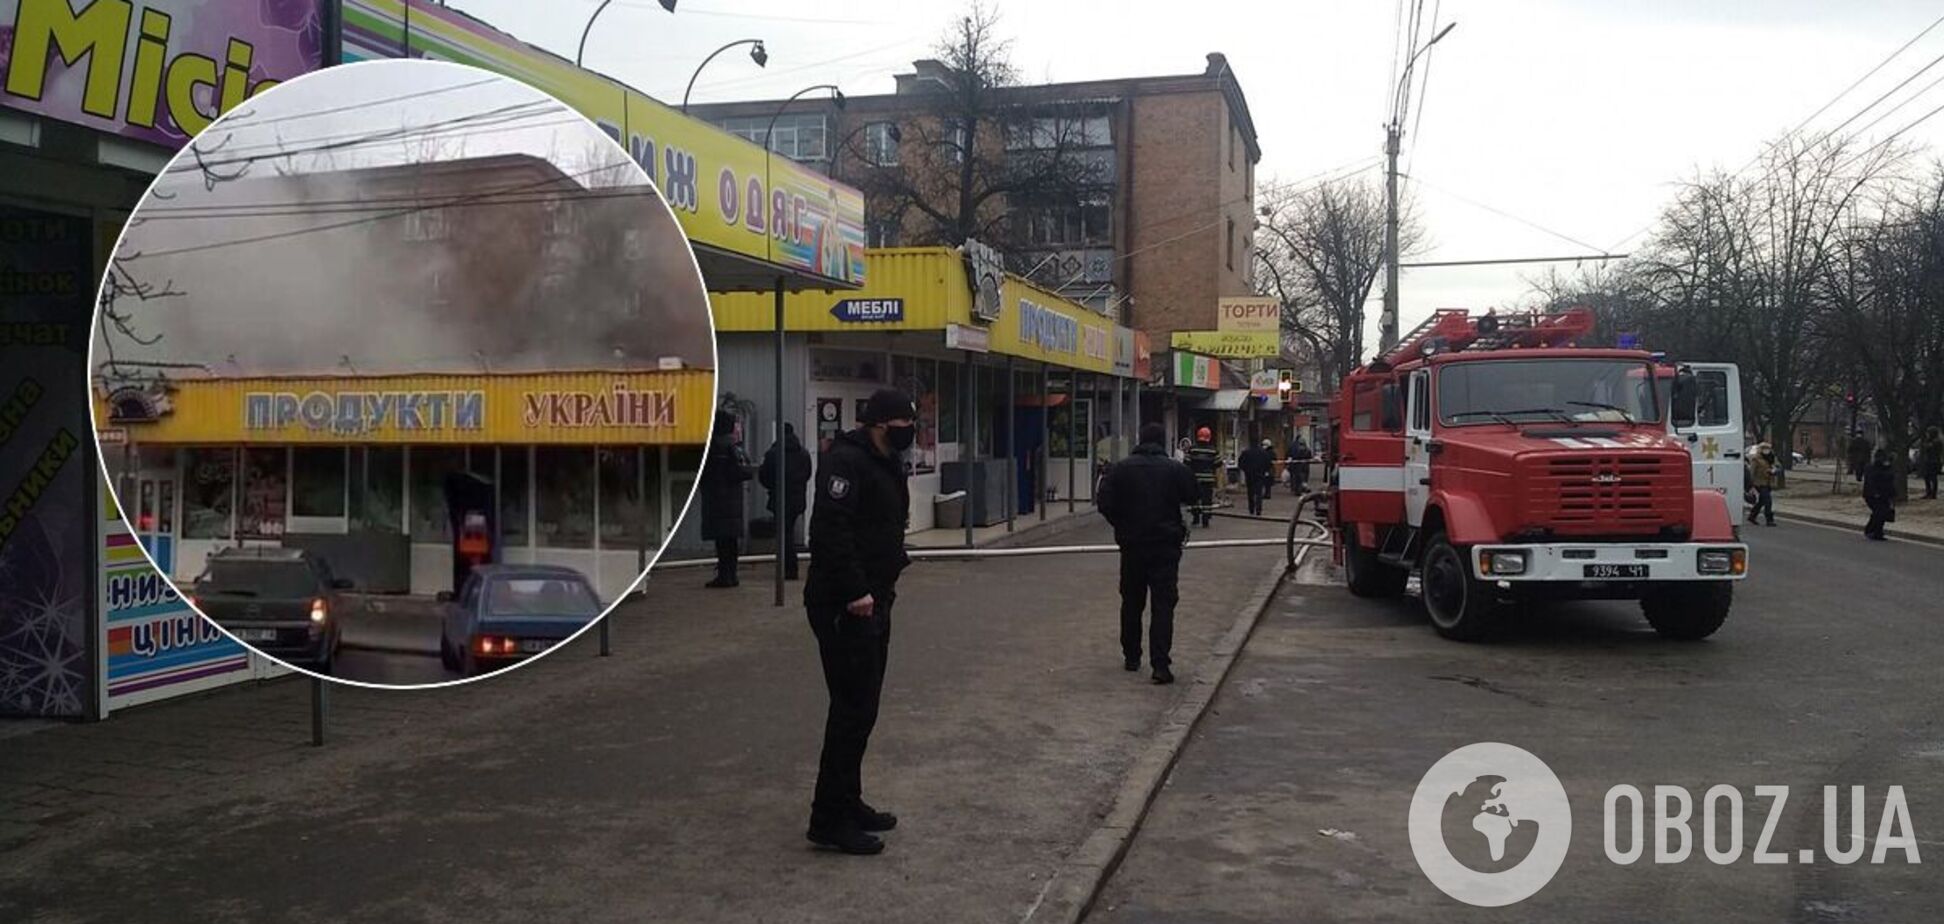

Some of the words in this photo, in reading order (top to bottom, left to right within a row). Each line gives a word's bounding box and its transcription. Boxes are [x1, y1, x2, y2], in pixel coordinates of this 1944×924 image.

[5, 0, 283, 139] Місі
[718, 167, 806, 244] ОДЯГ
[0, 269, 75, 293] інок
[847, 301, 899, 315] МЕБЛІ
[1221, 304, 1277, 319] ТОРТИ
[245, 391, 485, 433] ПРОДУКТИ
[524, 382, 677, 427] УКРАЇНИ
[1592, 565, 1620, 577] 9394
